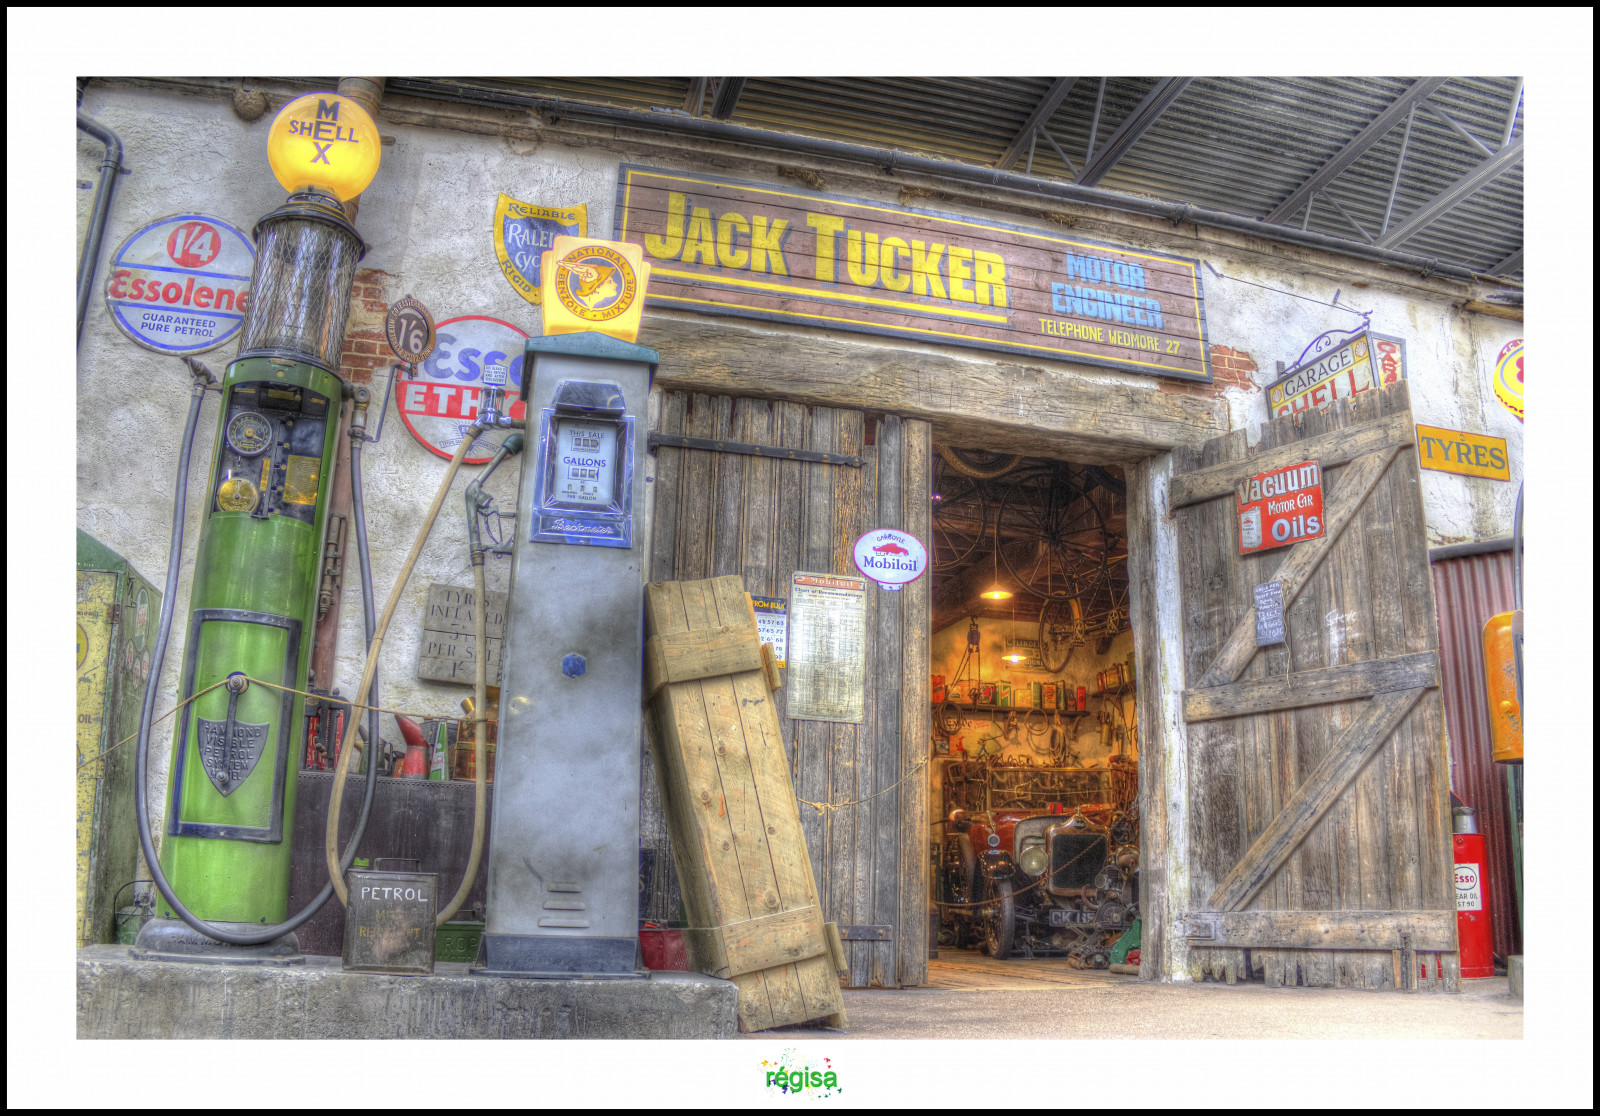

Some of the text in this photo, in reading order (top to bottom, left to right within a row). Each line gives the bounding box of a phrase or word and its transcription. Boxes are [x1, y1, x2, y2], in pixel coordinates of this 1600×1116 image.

[288, 120, 359, 143] SHELL
[508, 202, 576, 220] RELIABLE
[508, 223, 555, 248] RALEI
[567, 247, 627, 270] NATIONAL
[643, 191, 1008, 309] JACK TUCKER
[502, 259, 531, 293] RIGID
[1066, 251, 1147, 293] MOTOR
[558, 273, 587, 317] BENZOLE
[602, 278, 634, 318] MIXTURE
[1051, 281, 1165, 329] ENGINEER
[141, 321, 214, 338] PURE PETROL
[142, 312, 216, 328] GUARANTEED
[1038, 317, 1201, 355] TELEPHONE WEDMORE 27
[1285, 348, 1351, 396] GARAGE
[563, 457, 606, 467] GALLONS
[1420, 436, 1506, 470] TYRES
[1238, 464, 1320, 506] Vacuum
[1268, 493, 1314, 516] MOTOR CAR
[1272, 514, 1321, 542] Oils
[864, 555, 917, 571] Mobiloil
[429, 642, 456, 656] PER
[361, 886, 429, 901] PETROL
